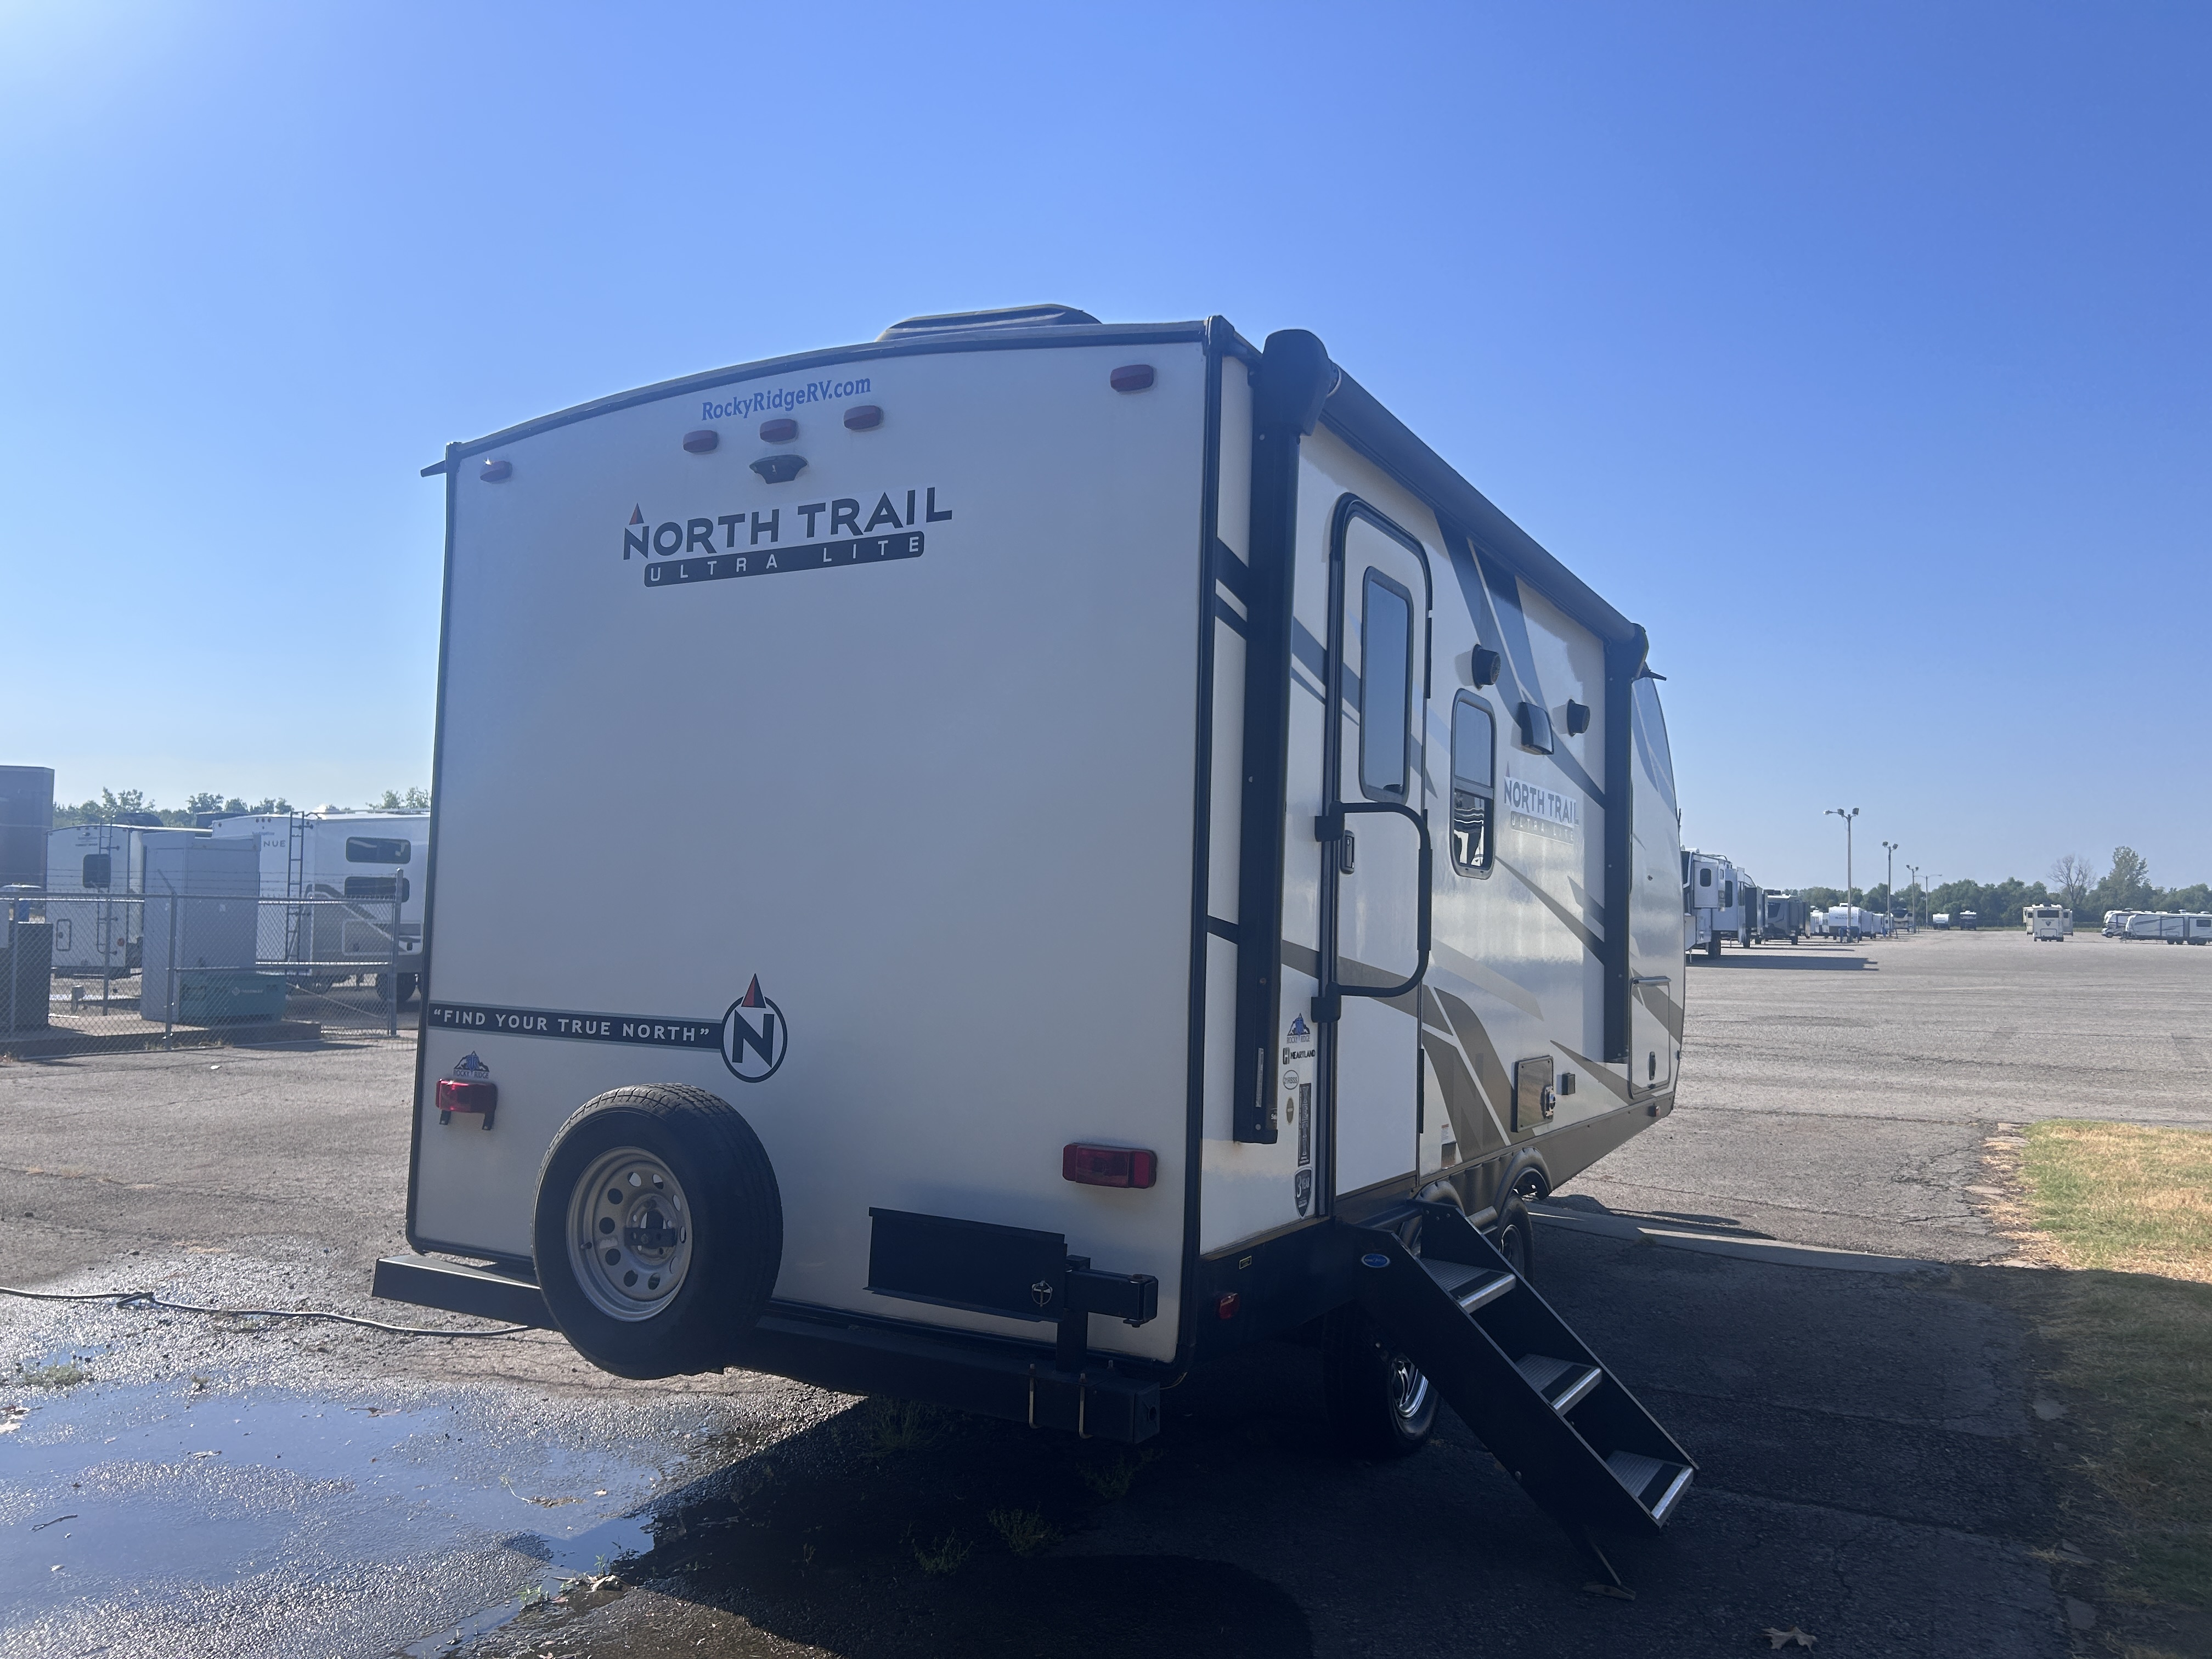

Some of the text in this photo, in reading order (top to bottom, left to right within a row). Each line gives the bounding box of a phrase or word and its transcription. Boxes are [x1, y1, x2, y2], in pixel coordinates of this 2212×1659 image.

[701, 377, 871, 421] RockyRidgeRV.com
[623, 487, 953, 560] NORTH TRAIL
[650, 536, 919, 583] ULTRA LITE
[1504, 779, 1579, 825] NORTH TRAIL
[1511, 814, 1573, 841] ULTRA LITE
[496, 1013, 548, 1031] YOUR
[558, 1018, 611, 1036] TRUE
[732, 1009, 775, 1068] N
[1290, 1049, 1316, 1059] HEARTLAND
